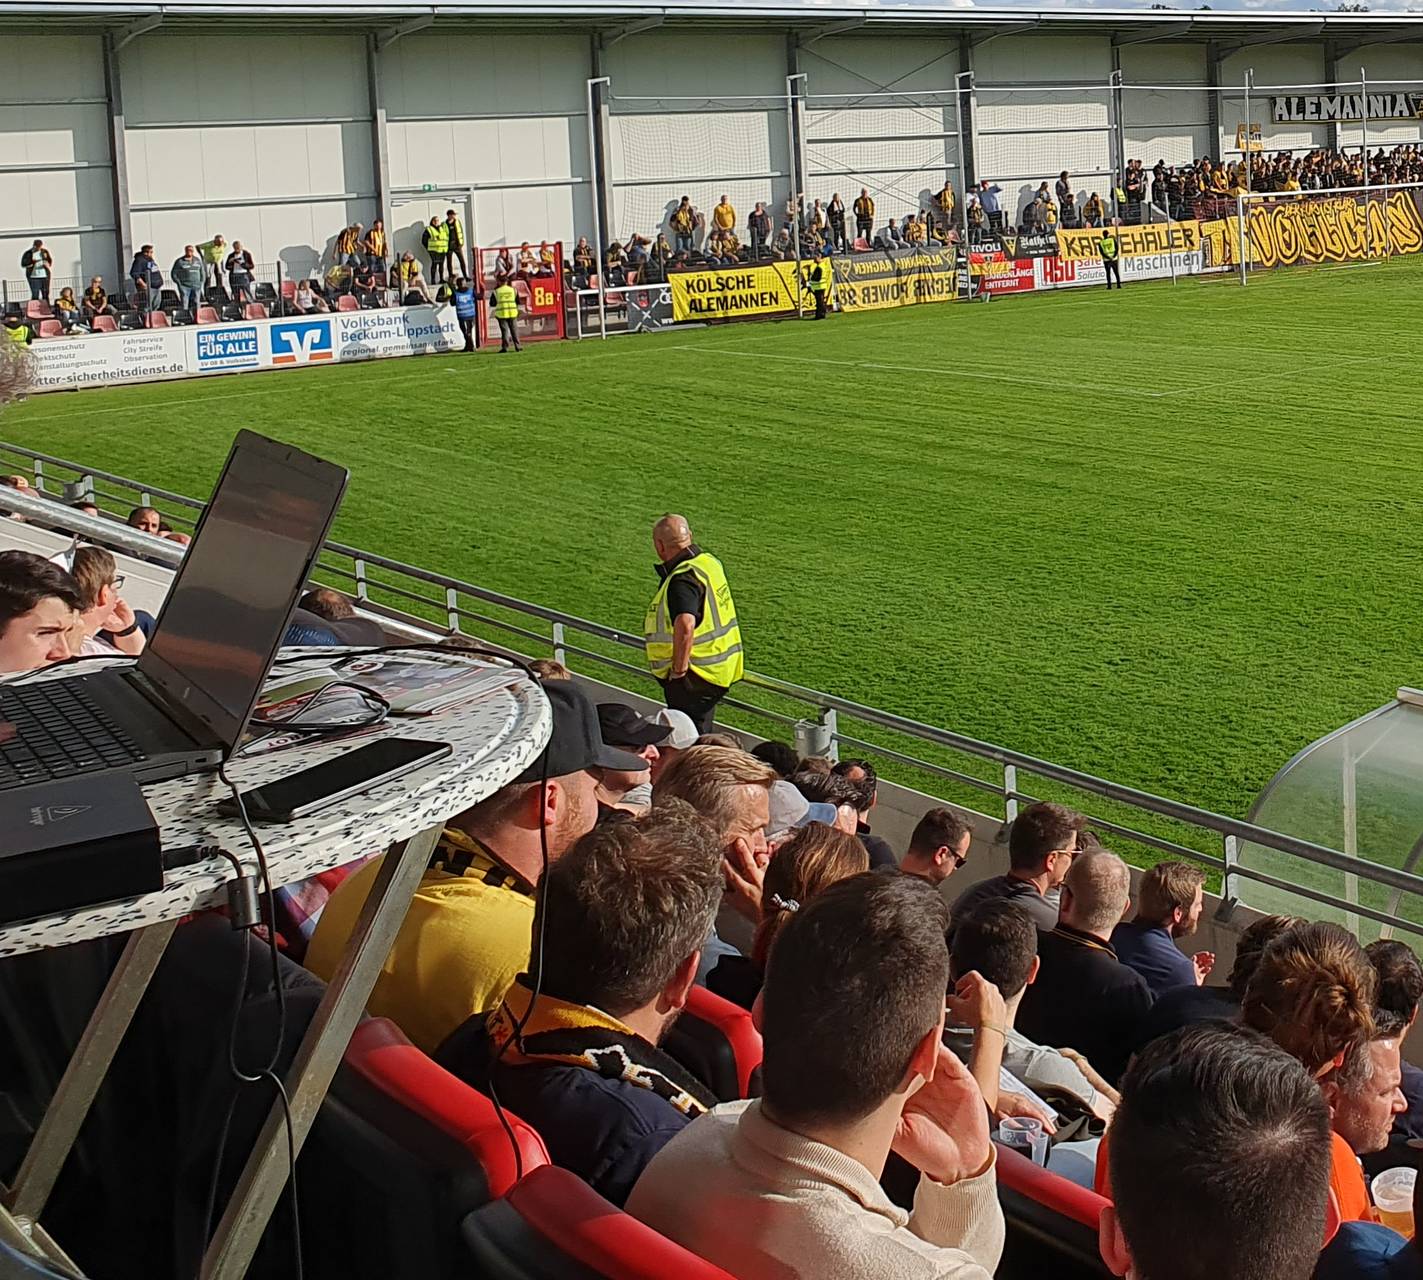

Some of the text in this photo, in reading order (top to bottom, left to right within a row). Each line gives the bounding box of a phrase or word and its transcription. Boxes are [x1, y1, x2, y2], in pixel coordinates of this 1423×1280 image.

[1275, 94, 1409, 120] ALEMANNIA
[971, 242, 1002, 253] TIVOLI
[1078, 269, 1106, 280] Solutio
[686, 274, 756, 294] KÖLSCHE
[534, 287, 554, 306] 8a
[689, 291, 779, 314] ALEMANNEN
[340, 313, 410, 329] Volksbank
[199, 330, 256, 342] EIN GEWINN
[341, 321, 455, 342] Beckum-Lippstadt
[123, 336, 164, 344] Fahrservice
[32, 343, 85, 352] ersonenschutz
[123, 344, 163, 354] City Streife
[200, 341, 256, 357] FÜR ALLE
[39, 353, 76, 361] ektschutz
[123, 352, 168, 363] Observation
[39, 359, 107, 371] anstaltungsschutz
[37, 363, 184, 385] tter-sicherheitsdienst.de
